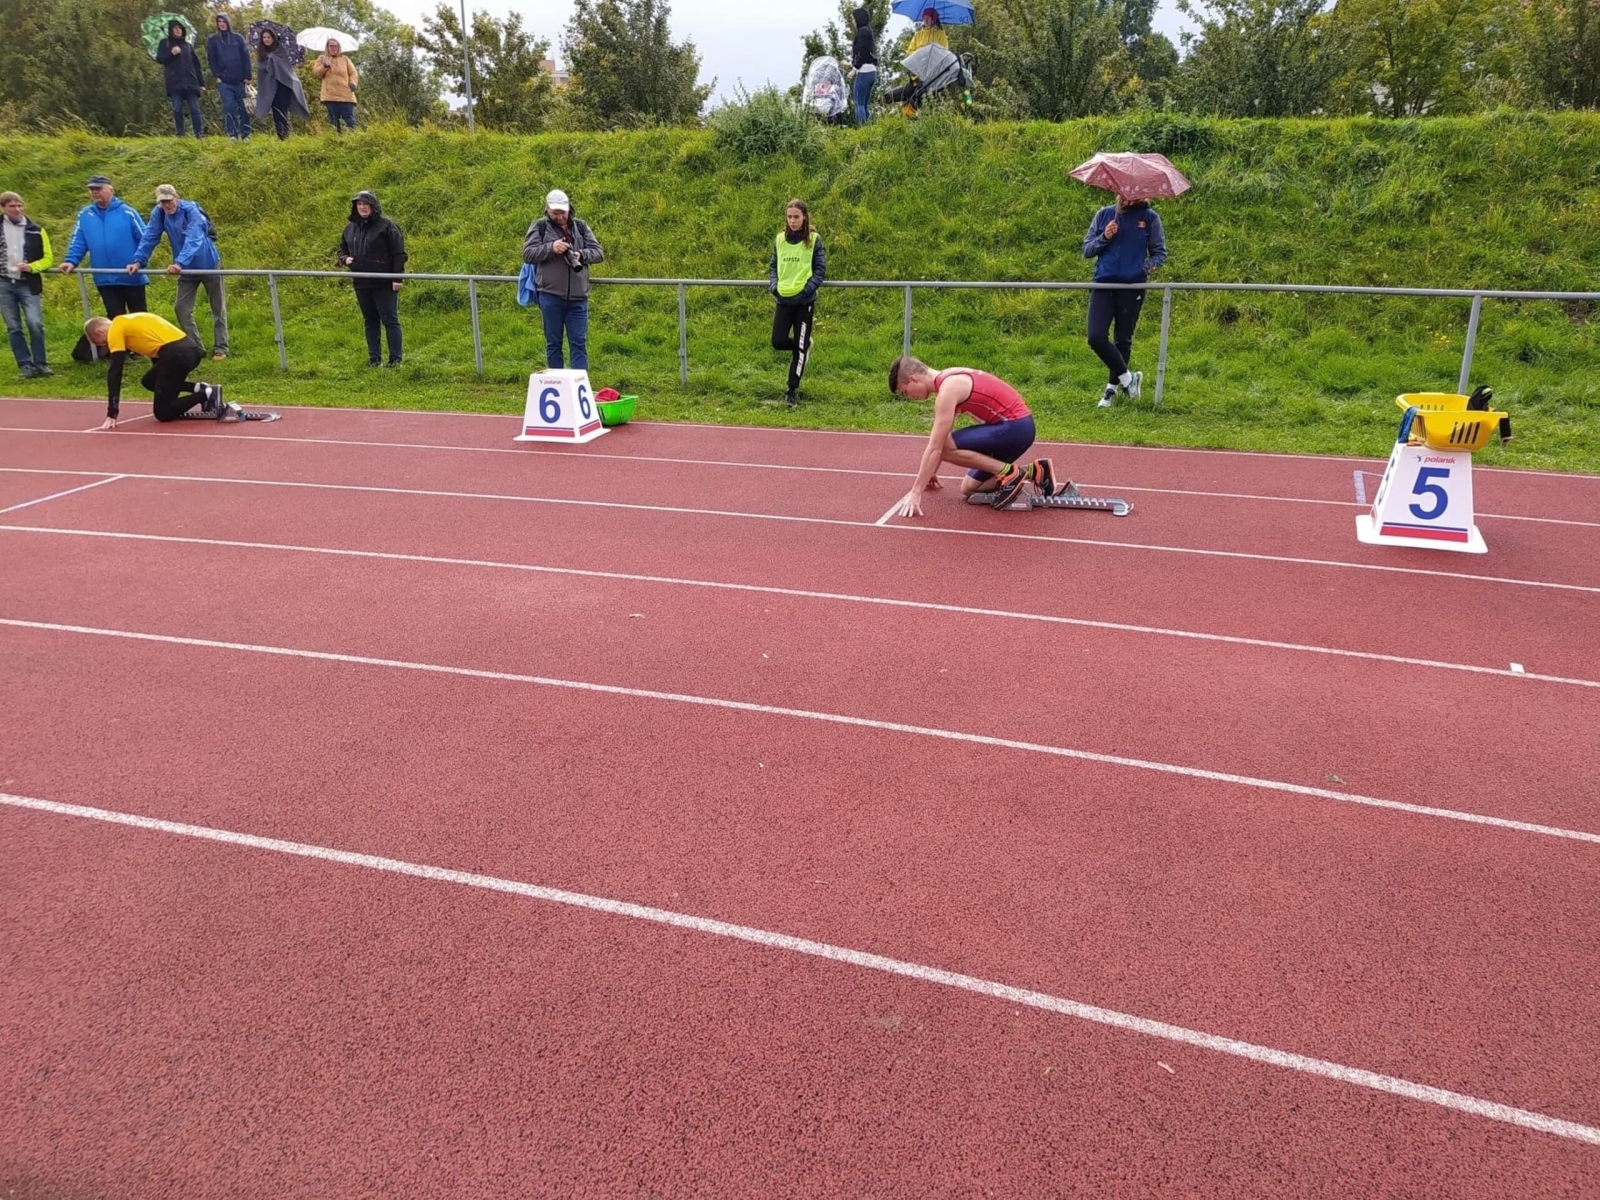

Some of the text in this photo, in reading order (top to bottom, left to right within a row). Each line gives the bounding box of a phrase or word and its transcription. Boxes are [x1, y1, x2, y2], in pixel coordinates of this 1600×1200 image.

[539, 387, 561, 424] 6
[578, 384, 591, 420] 6
[1424, 456, 1456, 464] polanik
[1409, 466, 1450, 520] 5
